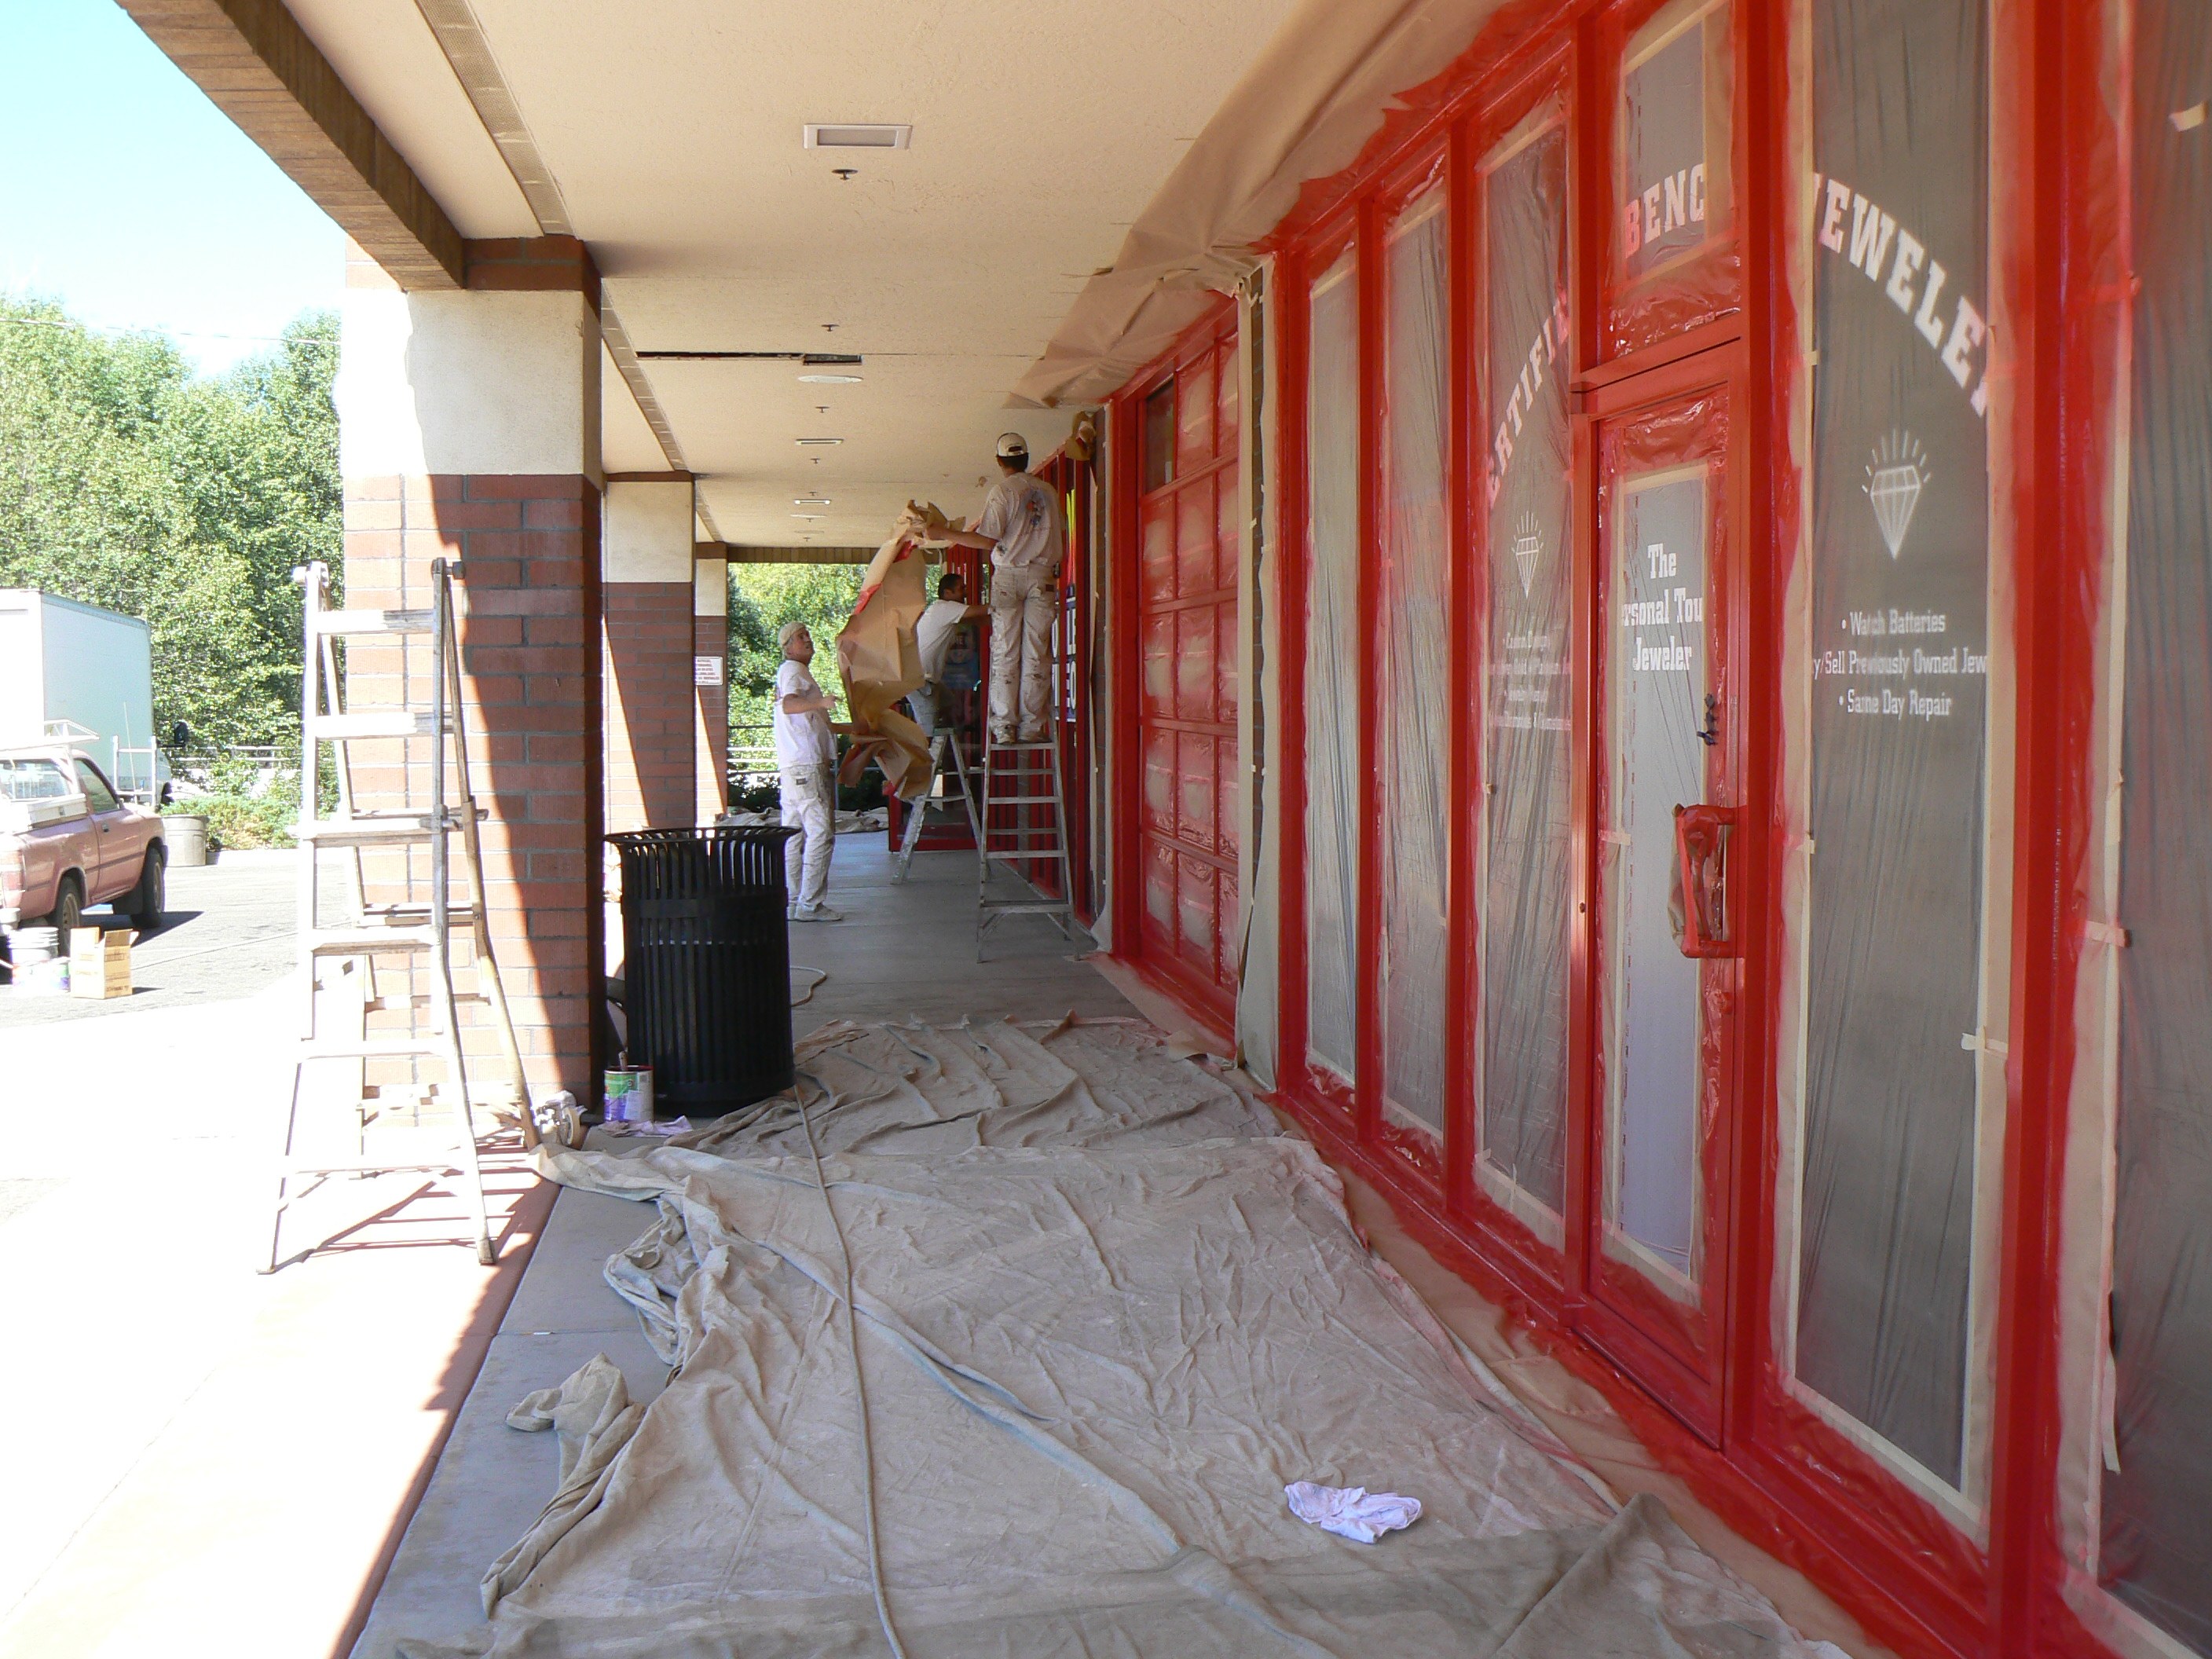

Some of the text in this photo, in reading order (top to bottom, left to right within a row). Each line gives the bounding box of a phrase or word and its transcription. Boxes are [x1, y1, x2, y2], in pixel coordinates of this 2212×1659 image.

[1812, 172, 1987, 417] EWELE
[1647, 543, 1677, 579] The
[1850, 609, 1946, 635] Watch Batteries
[1632, 635, 1692, 671] Jeweler
[1848, 649, 1910, 679] Previously
[1914, 646, 1957, 674] Owned
[1848, 689, 1951, 721] Same Day Repair
